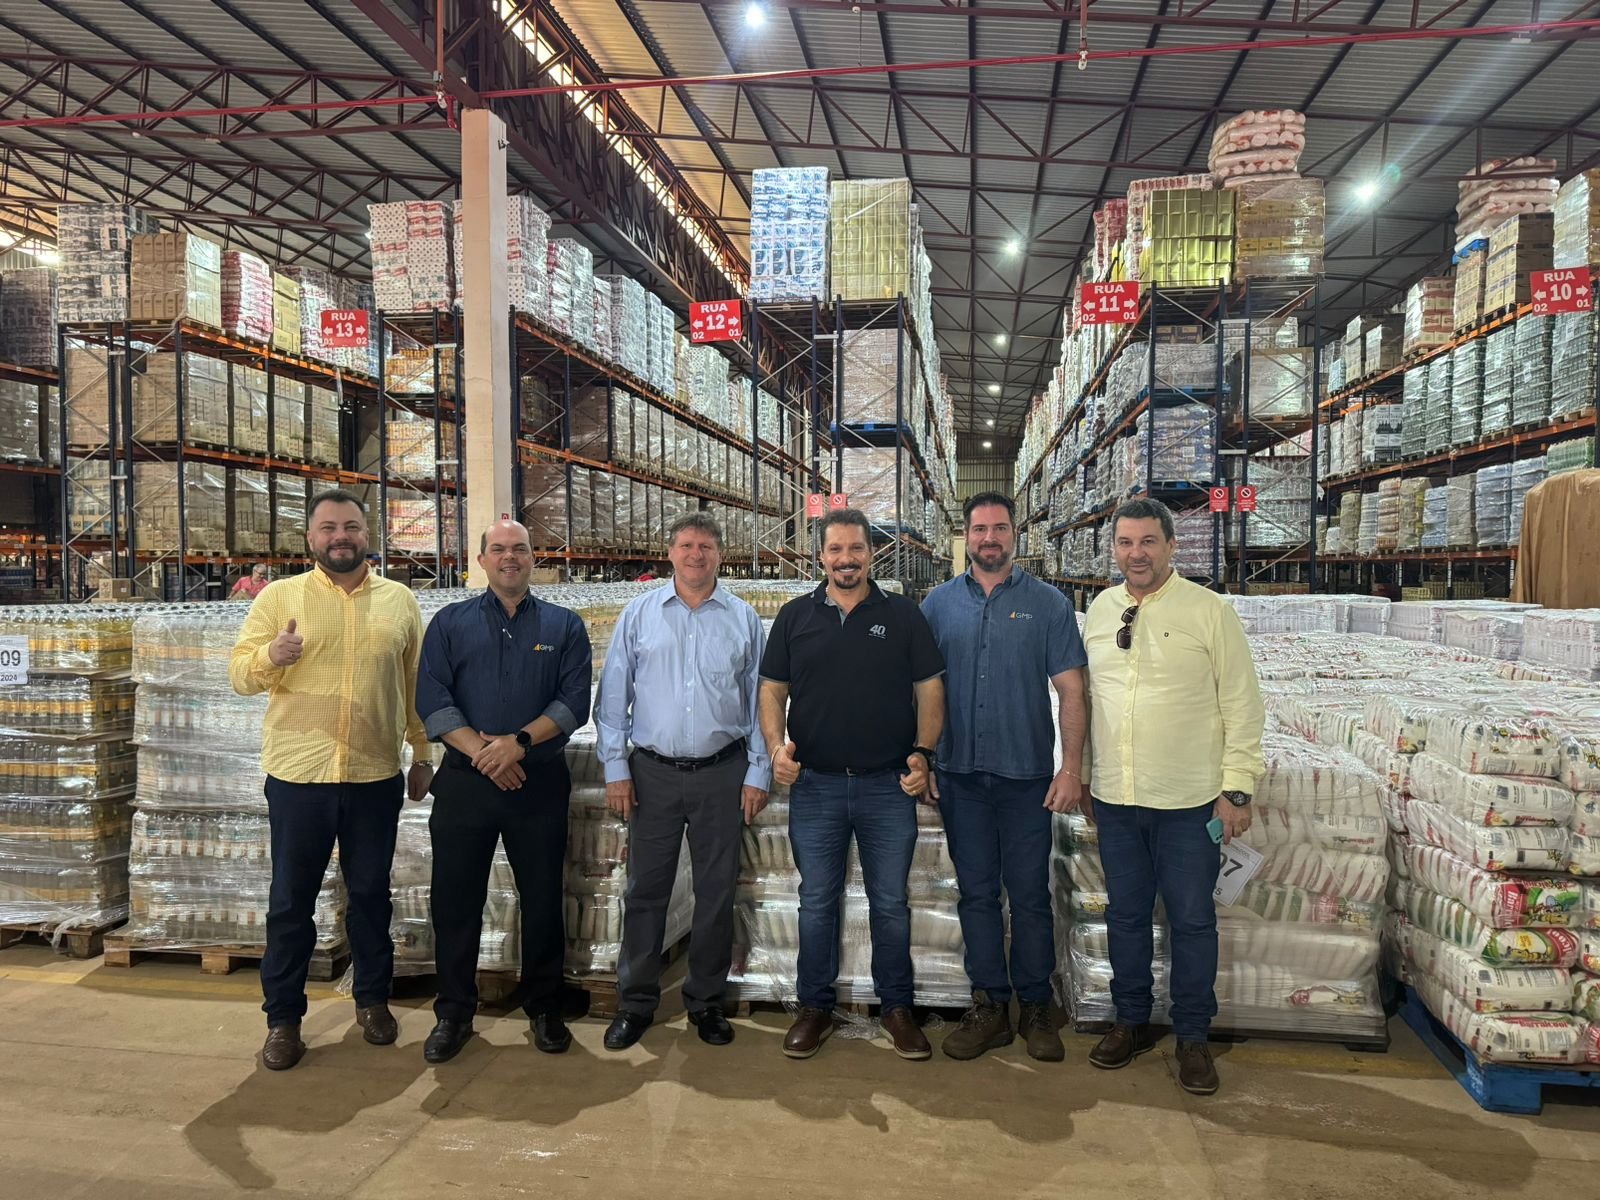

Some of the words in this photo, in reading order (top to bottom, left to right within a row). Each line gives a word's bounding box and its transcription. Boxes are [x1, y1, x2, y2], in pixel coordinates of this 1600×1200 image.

[1543, 270, 1576, 283] RUA
[1094, 284, 1125, 294] RUA
[1550, 282, 1572, 302] 10
[700, 303, 728, 313] RUA
[1099, 295, 1120, 313] 11
[1533, 302, 1548, 312] 02
[1576, 298, 1591, 308] 01
[331, 312, 356, 321] RUA
[706, 313, 725, 331] 12
[1082, 313, 1096, 322] 02
[1123, 311, 1137, 320] 01
[335, 322, 354, 338] 13
[692, 331, 705, 340] 02
[728, 328, 740, 337] 01
[323, 337, 335, 346] 01
[355, 336, 368, 345] 02
[869, 624, 886, 635] 40
